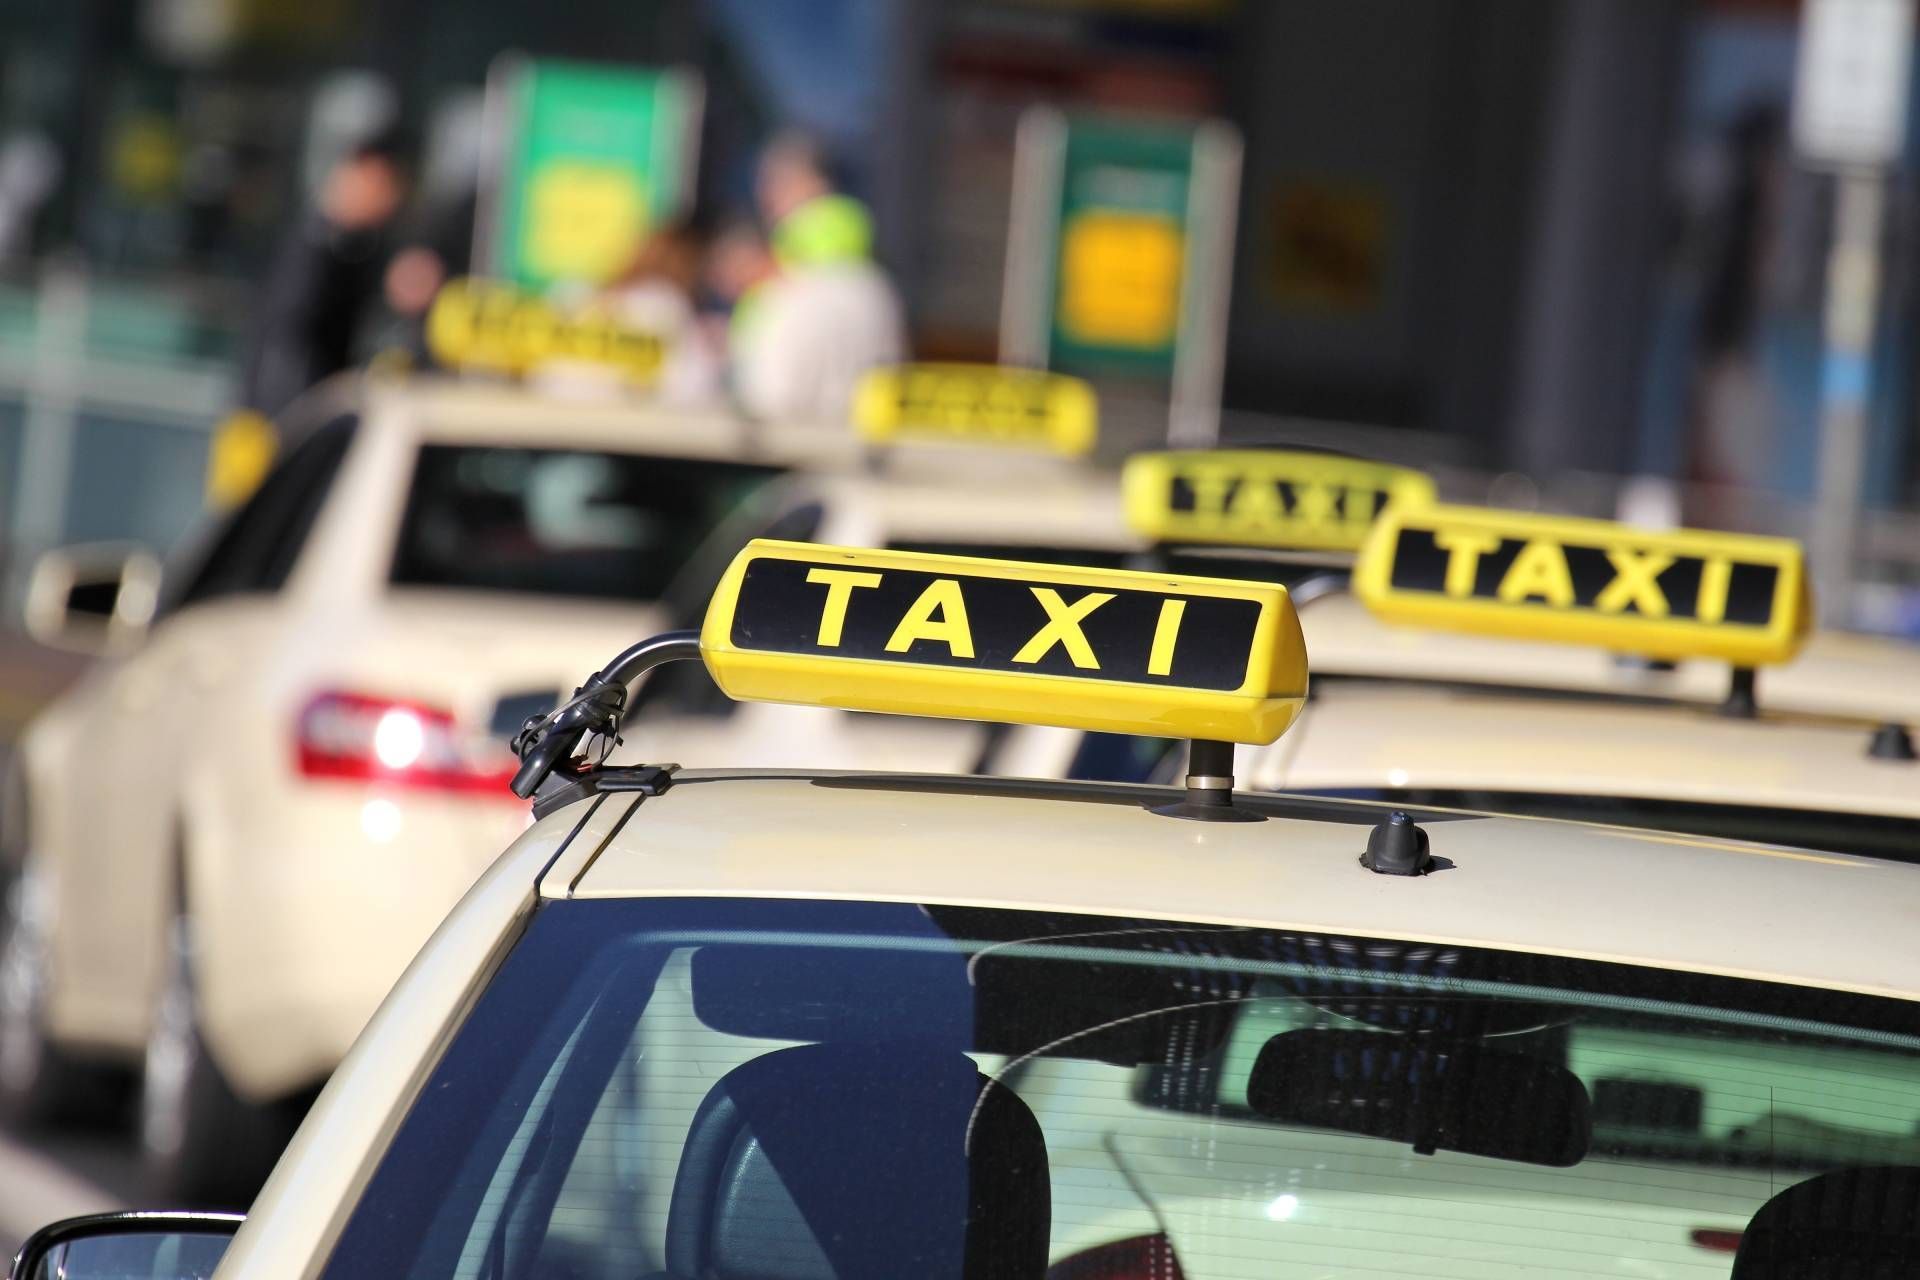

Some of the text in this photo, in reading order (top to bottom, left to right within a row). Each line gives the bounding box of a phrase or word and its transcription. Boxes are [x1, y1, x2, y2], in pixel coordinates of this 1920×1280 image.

[1187, 474, 1378, 520] TAXI
[805, 568, 1187, 676] TAXI
[1434, 529, 1732, 624] TAXI
